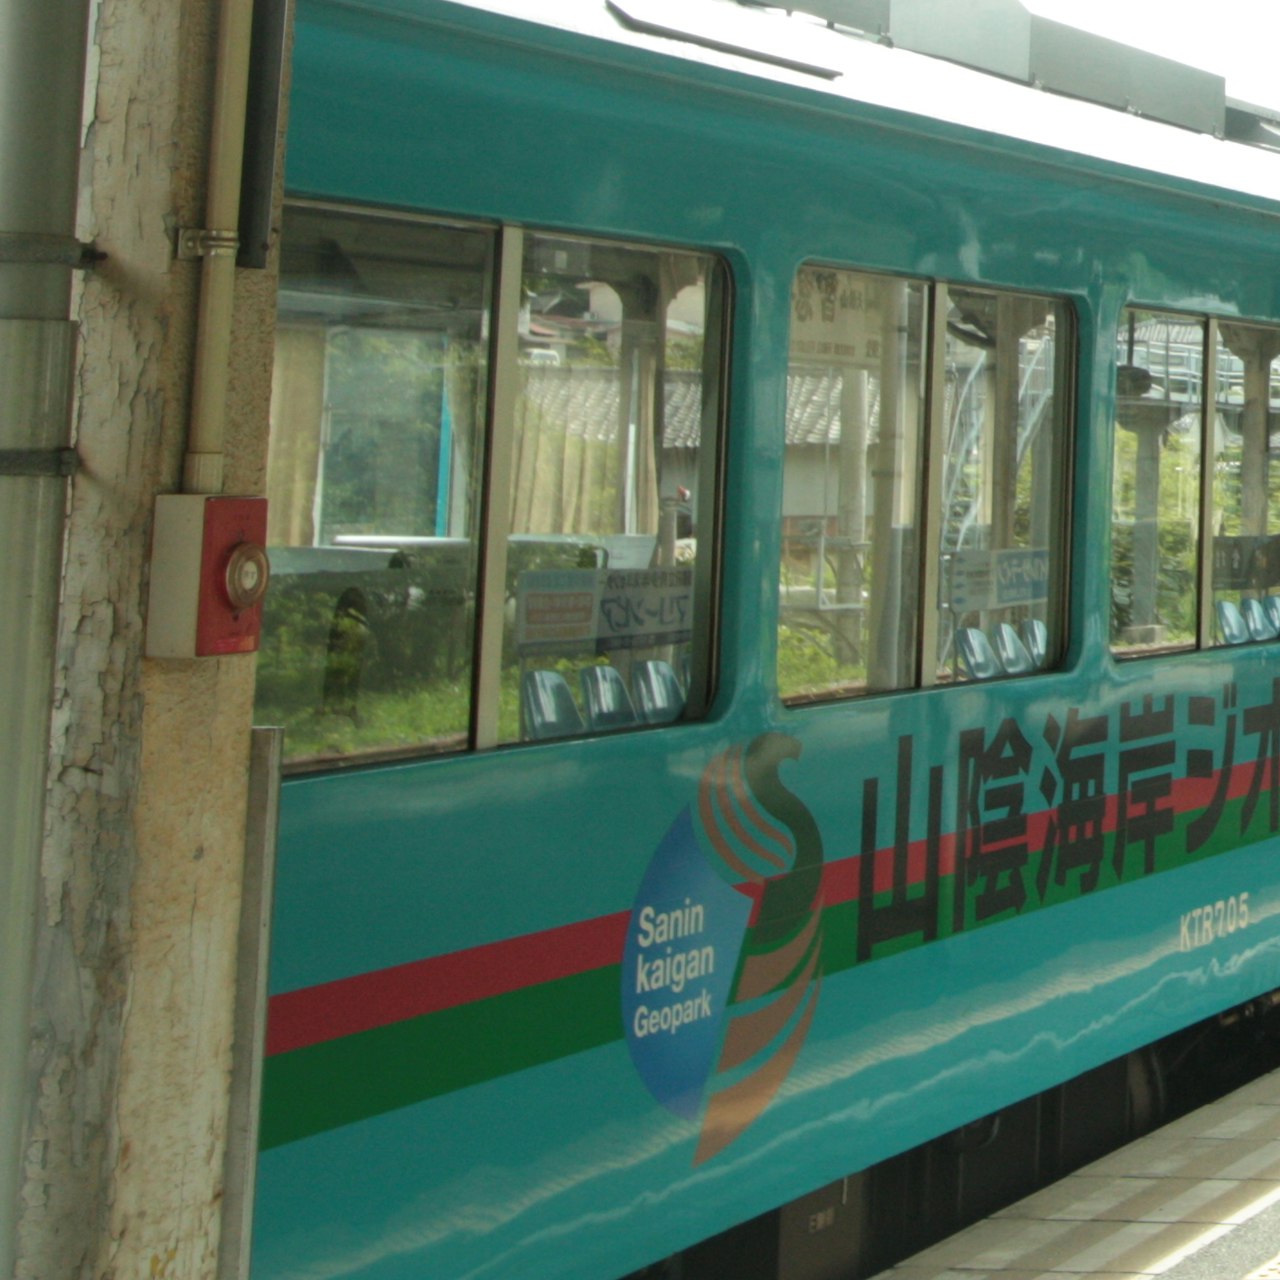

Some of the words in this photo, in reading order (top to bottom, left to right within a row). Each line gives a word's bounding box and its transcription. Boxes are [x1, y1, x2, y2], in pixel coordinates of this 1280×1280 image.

[637, 897, 705, 948] Sanin
[1180, 891, 1250, 953] KTR705
[635, 945, 715, 994] kaigan
[633, 987, 712, 1039] Geopark
